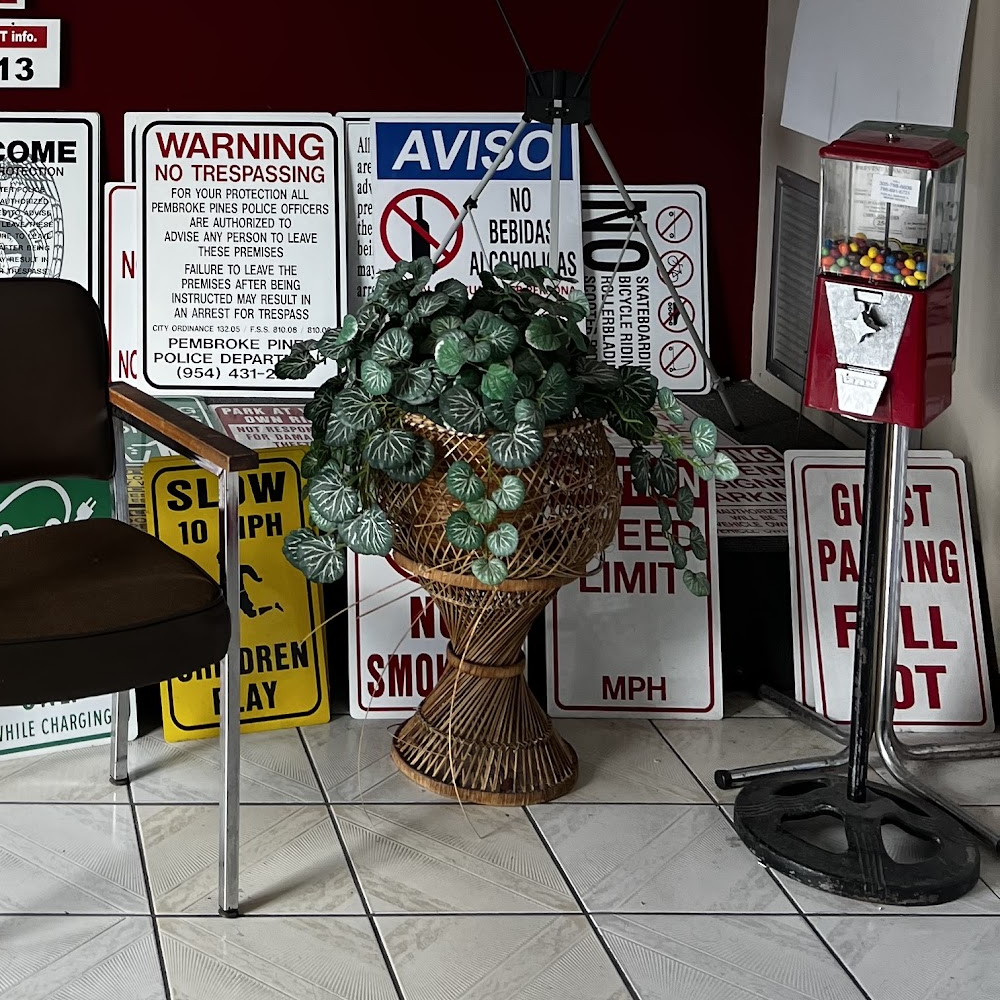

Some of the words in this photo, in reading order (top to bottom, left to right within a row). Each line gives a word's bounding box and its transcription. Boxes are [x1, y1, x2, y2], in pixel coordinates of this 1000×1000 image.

[11, 31, 37, 42] info.
[156, 132, 324, 160] WARNING
[391, 130, 552, 171] AVISO
[156, 164, 182, 181] NO
[192, 165, 324, 183] TRESPASSING
[172, 188, 191, 198] FOR
[196, 188, 222, 199] YOUR
[226, 189, 287, 199] PROTECTION
[292, 190, 309, 199] ALL
[510, 187, 531, 212] NO
[152, 202, 205, 212] PEMBROKE
[210, 203, 238, 213] PINES
[242, 203, 276, 214] POLICE
[281, 204, 329, 214] OFFICERS
[190, 218, 208, 227] ARE
[213, 218, 274, 228] AUTHORIZED
[279, 218, 291, 228] TO
[489, 219, 551, 244] BEBIDAS
[165, 232, 199, 242] ADVISE
[204, 232, 222, 242] ANY
[227, 232, 268, 242] PERSON
[271, 233, 283, 243] TO
[288, 233, 317, 243] LEAVE
[198, 246, 229, 256] THESE
[235, 247, 283, 258] PREMISES
[177, 367, 221, 379] (954)
[178, 520, 207, 545] 10
[580, 562, 676, 595] LIMIT
[602, 677, 666, 701] MPH
[41, 708, 111, 736] CHARGING
